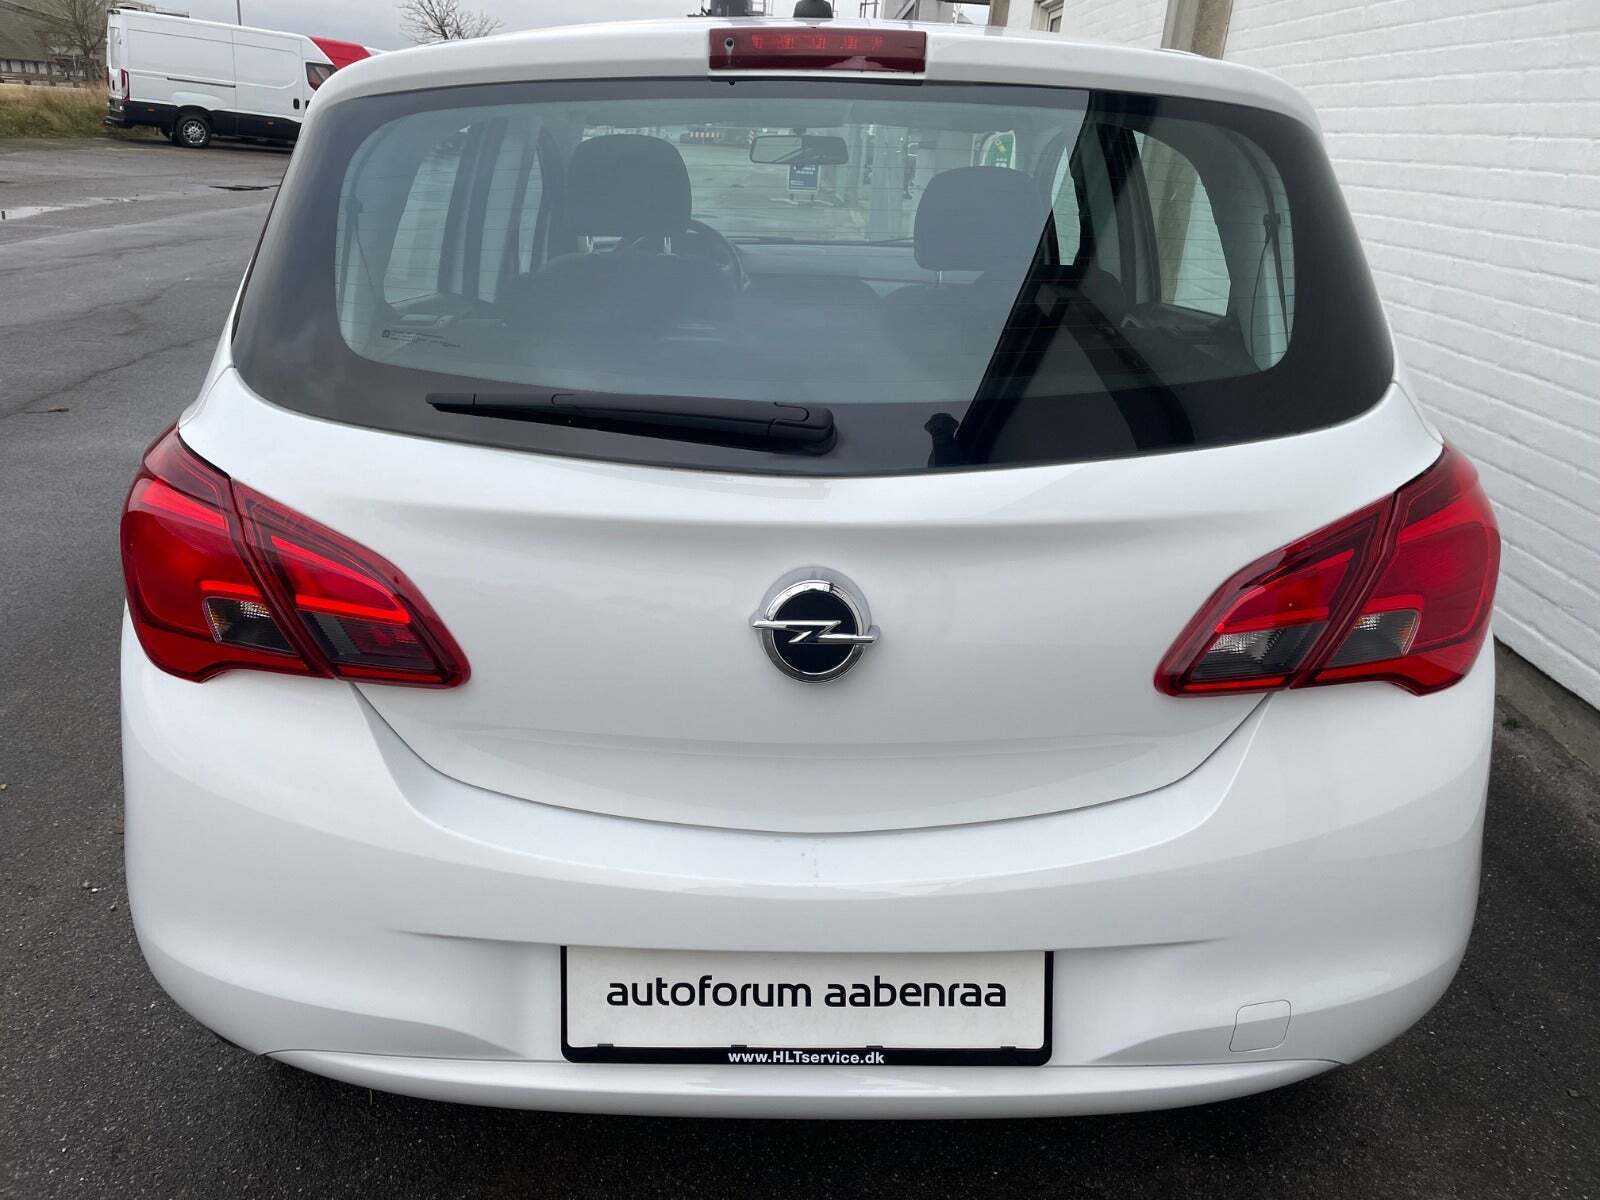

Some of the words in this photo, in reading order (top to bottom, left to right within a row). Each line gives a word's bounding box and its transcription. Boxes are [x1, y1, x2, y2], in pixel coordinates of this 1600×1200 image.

[607, 975, 812, 1007] autoforum
[825, 975, 1007, 1007] aabenraa
[728, 1050, 885, 1065] www.HLTservice.dk
